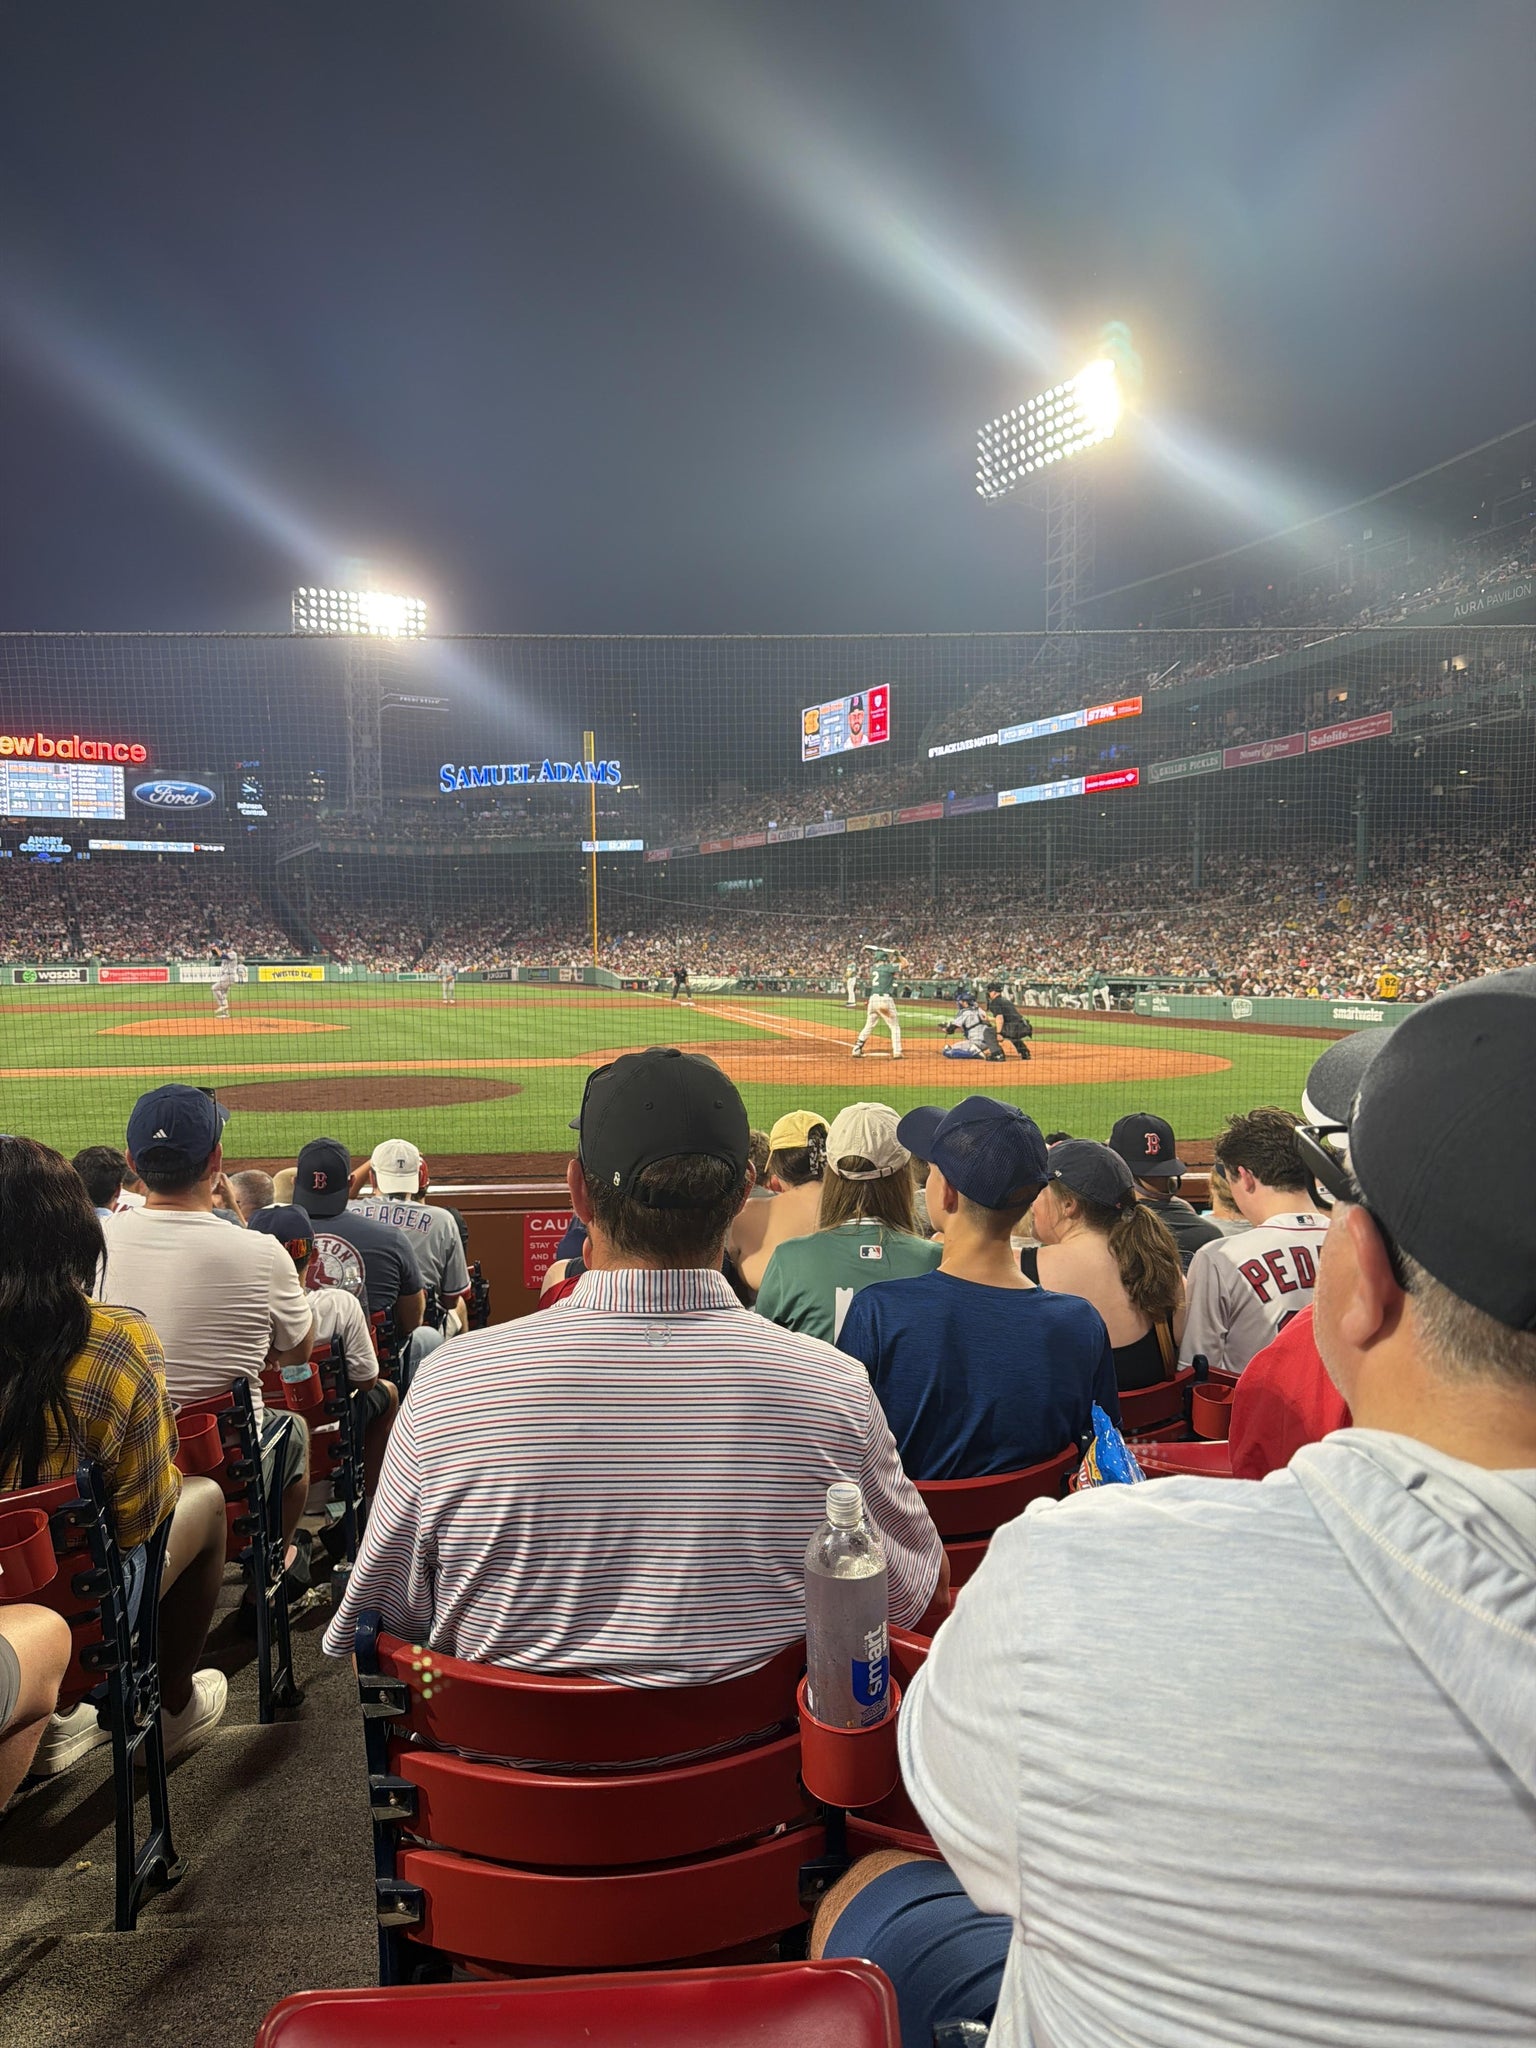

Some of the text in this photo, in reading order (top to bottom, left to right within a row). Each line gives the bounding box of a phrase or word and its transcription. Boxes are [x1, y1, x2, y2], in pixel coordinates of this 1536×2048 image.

[1486, 583, 1532, 607] PAVILION
[1087, 705, 1116, 721] STIHL
[1310, 729, 1348, 747] Safelite
[439, 758, 622, 793] SAMUEL ADAMS
[149, 784, 199, 805] Ford
[19, 843, 72, 853] ORCHARD
[27, 836, 63, 845] ANGRY
[38, 968, 81, 979] wasabi
[271, 970, 300, 979] TWISTED
[872, 971, 879, 987] 2
[1385, 977, 1397, 987] 62
[1144, 1132, 1161, 1155] B
[397, 1159, 405, 1168] T
[312, 1171, 328, 1189] B
[530, 1219, 570, 1231] CAU
[1238, 1246, 1322, 1304] PED
[864, 1624, 883, 1695] smart
